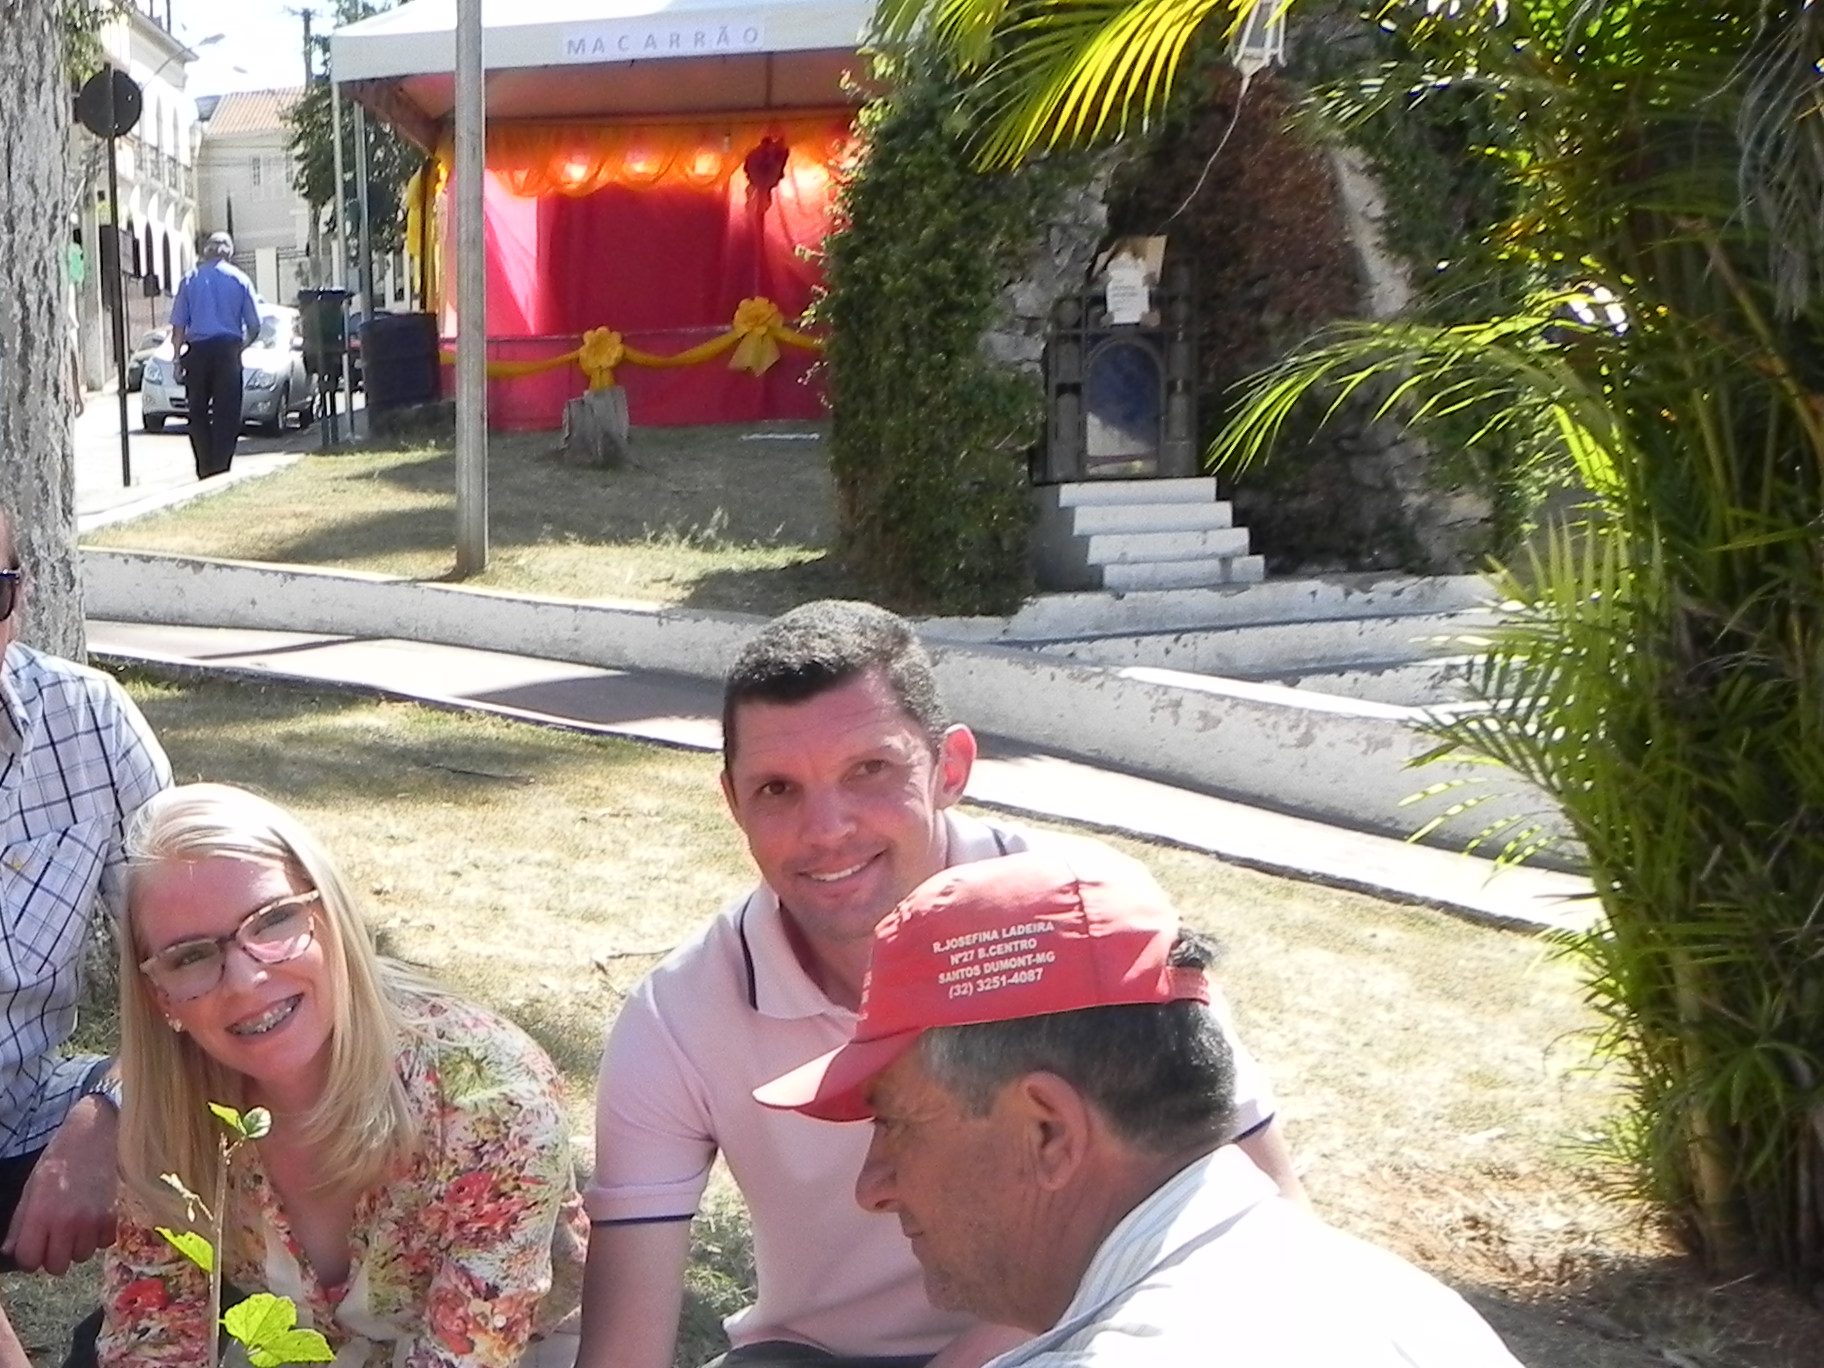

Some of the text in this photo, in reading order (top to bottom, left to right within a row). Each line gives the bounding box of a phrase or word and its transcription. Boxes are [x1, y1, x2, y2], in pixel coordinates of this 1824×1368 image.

[567, 25, 759, 55] MACARRÃO
[1002, 921, 1055, 938] LADEIRA
[978, 938, 1037, 959] B.CENTRO
[938, 951, 1056, 984] SANTOS DUMONT-MG
[949, 967, 1044, 999] (32) 3251-4087
